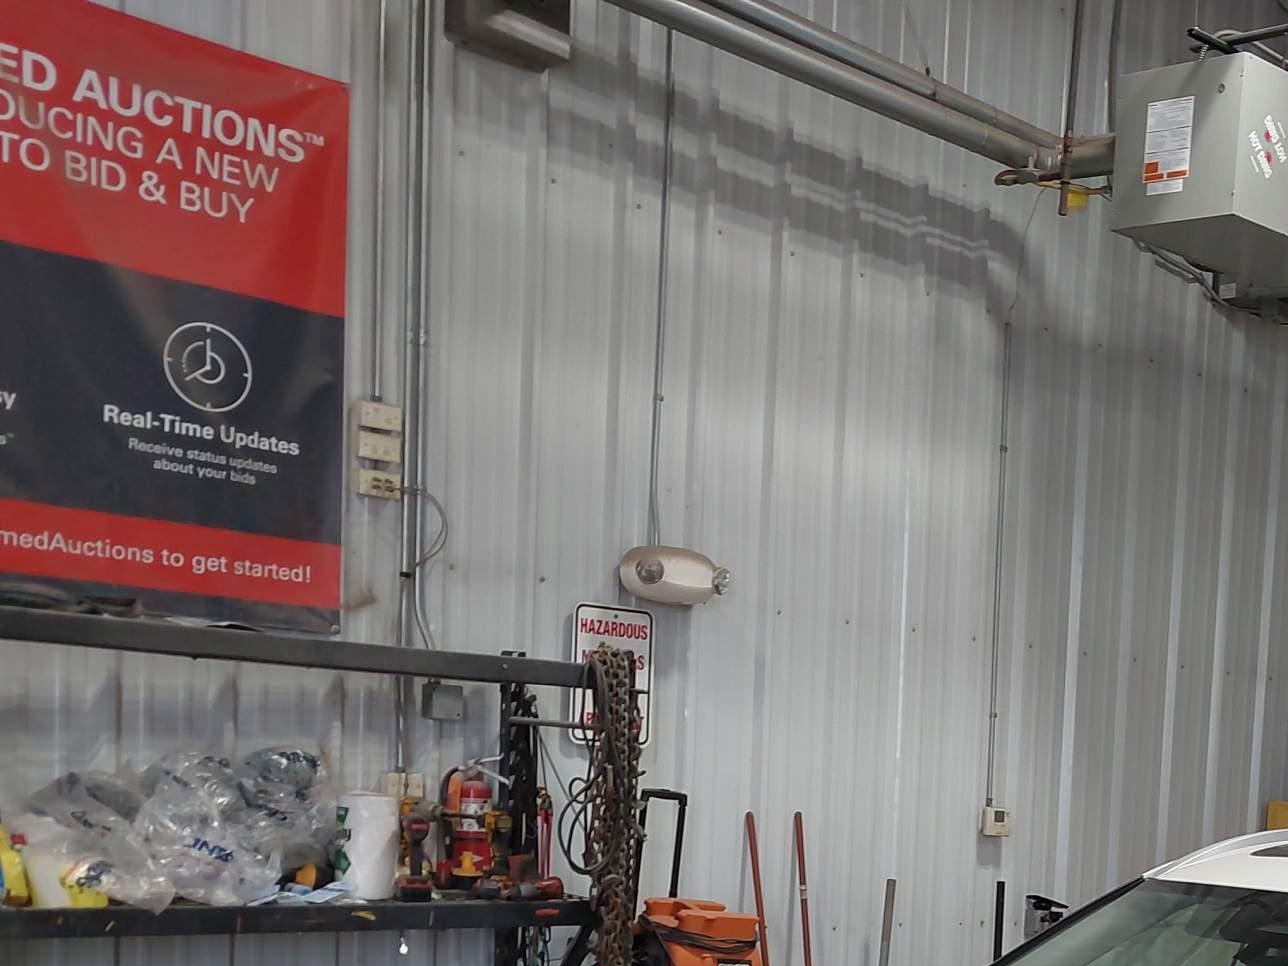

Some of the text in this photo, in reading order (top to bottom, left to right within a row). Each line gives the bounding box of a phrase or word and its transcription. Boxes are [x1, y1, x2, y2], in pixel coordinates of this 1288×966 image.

[0, 130, 254, 223] TO BID & BUY
[156, 138, 183, 170] A
[195, 147, 279, 192] NEW
[103, 404, 300, 455] Real-Time Updates
[128, 437, 277, 474] Receive status updates
[153, 458, 256, 485] about your bids
[161, 549, 184, 567] to
[192, 554, 227, 577] get
[234, 561, 311, 583] started!
[580, 617, 648, 640] HAZARDOUS
